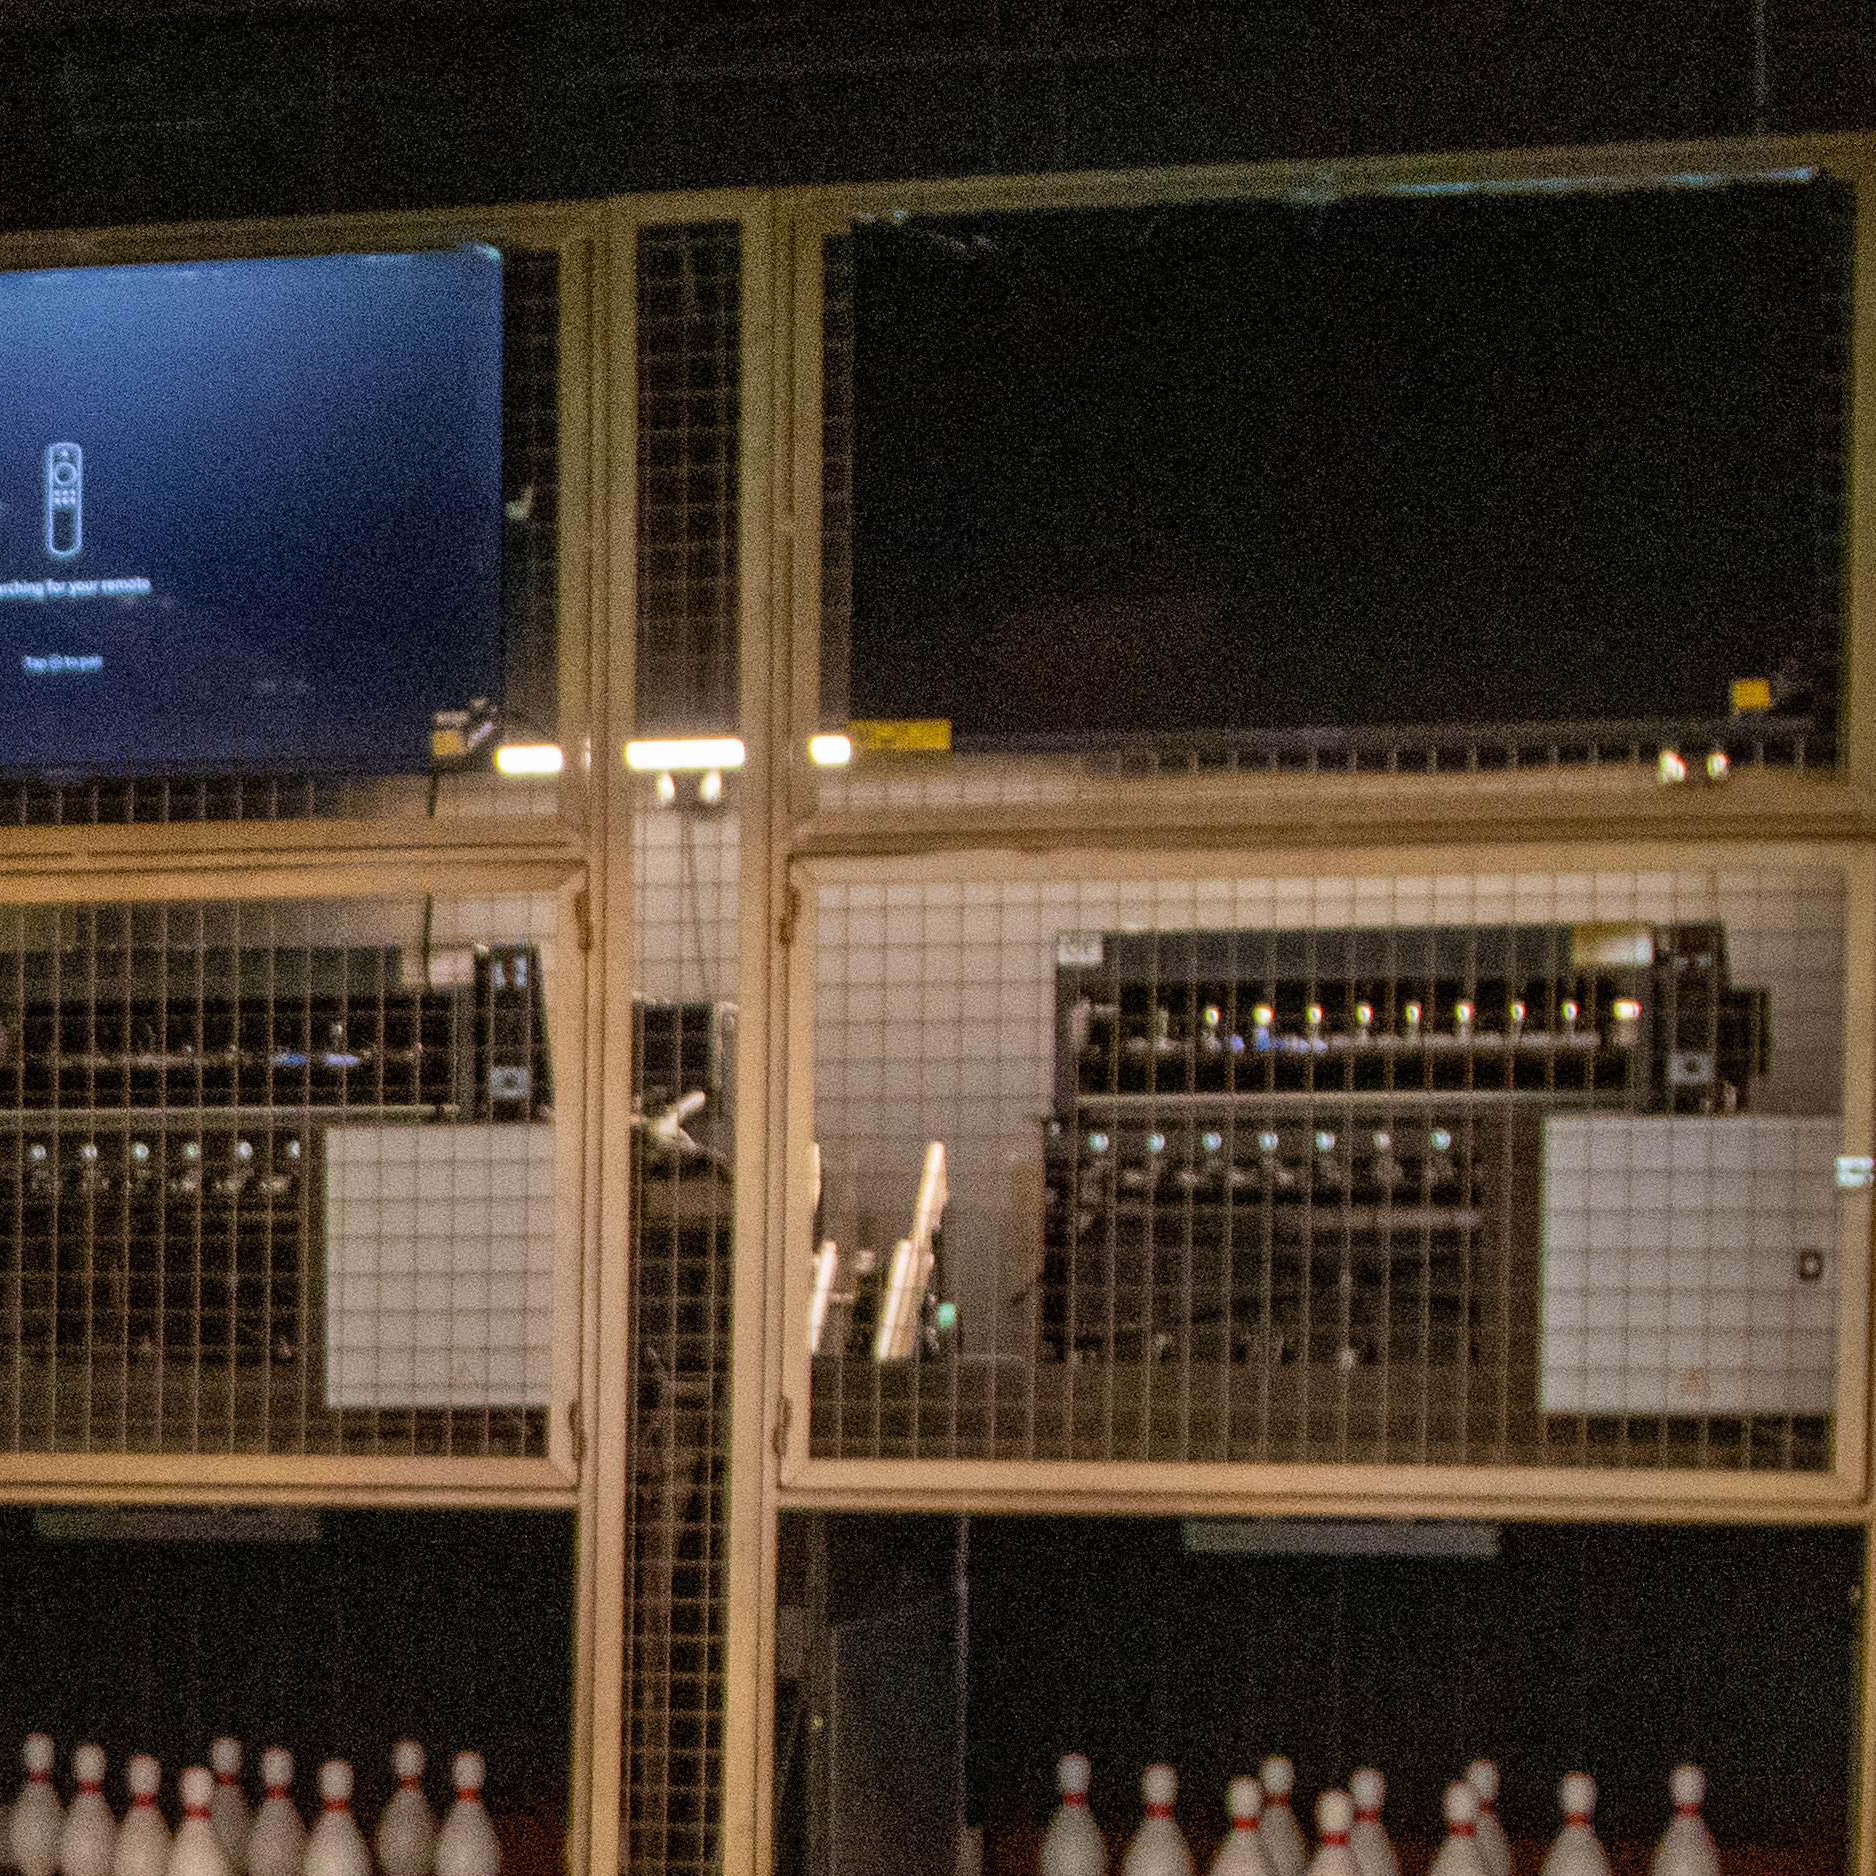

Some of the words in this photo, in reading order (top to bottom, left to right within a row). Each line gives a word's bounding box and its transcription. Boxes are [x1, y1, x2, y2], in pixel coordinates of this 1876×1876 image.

[46, 578, 66, 597] for
[68, 580, 97, 599] your
[100, 577, 151, 596] remote
